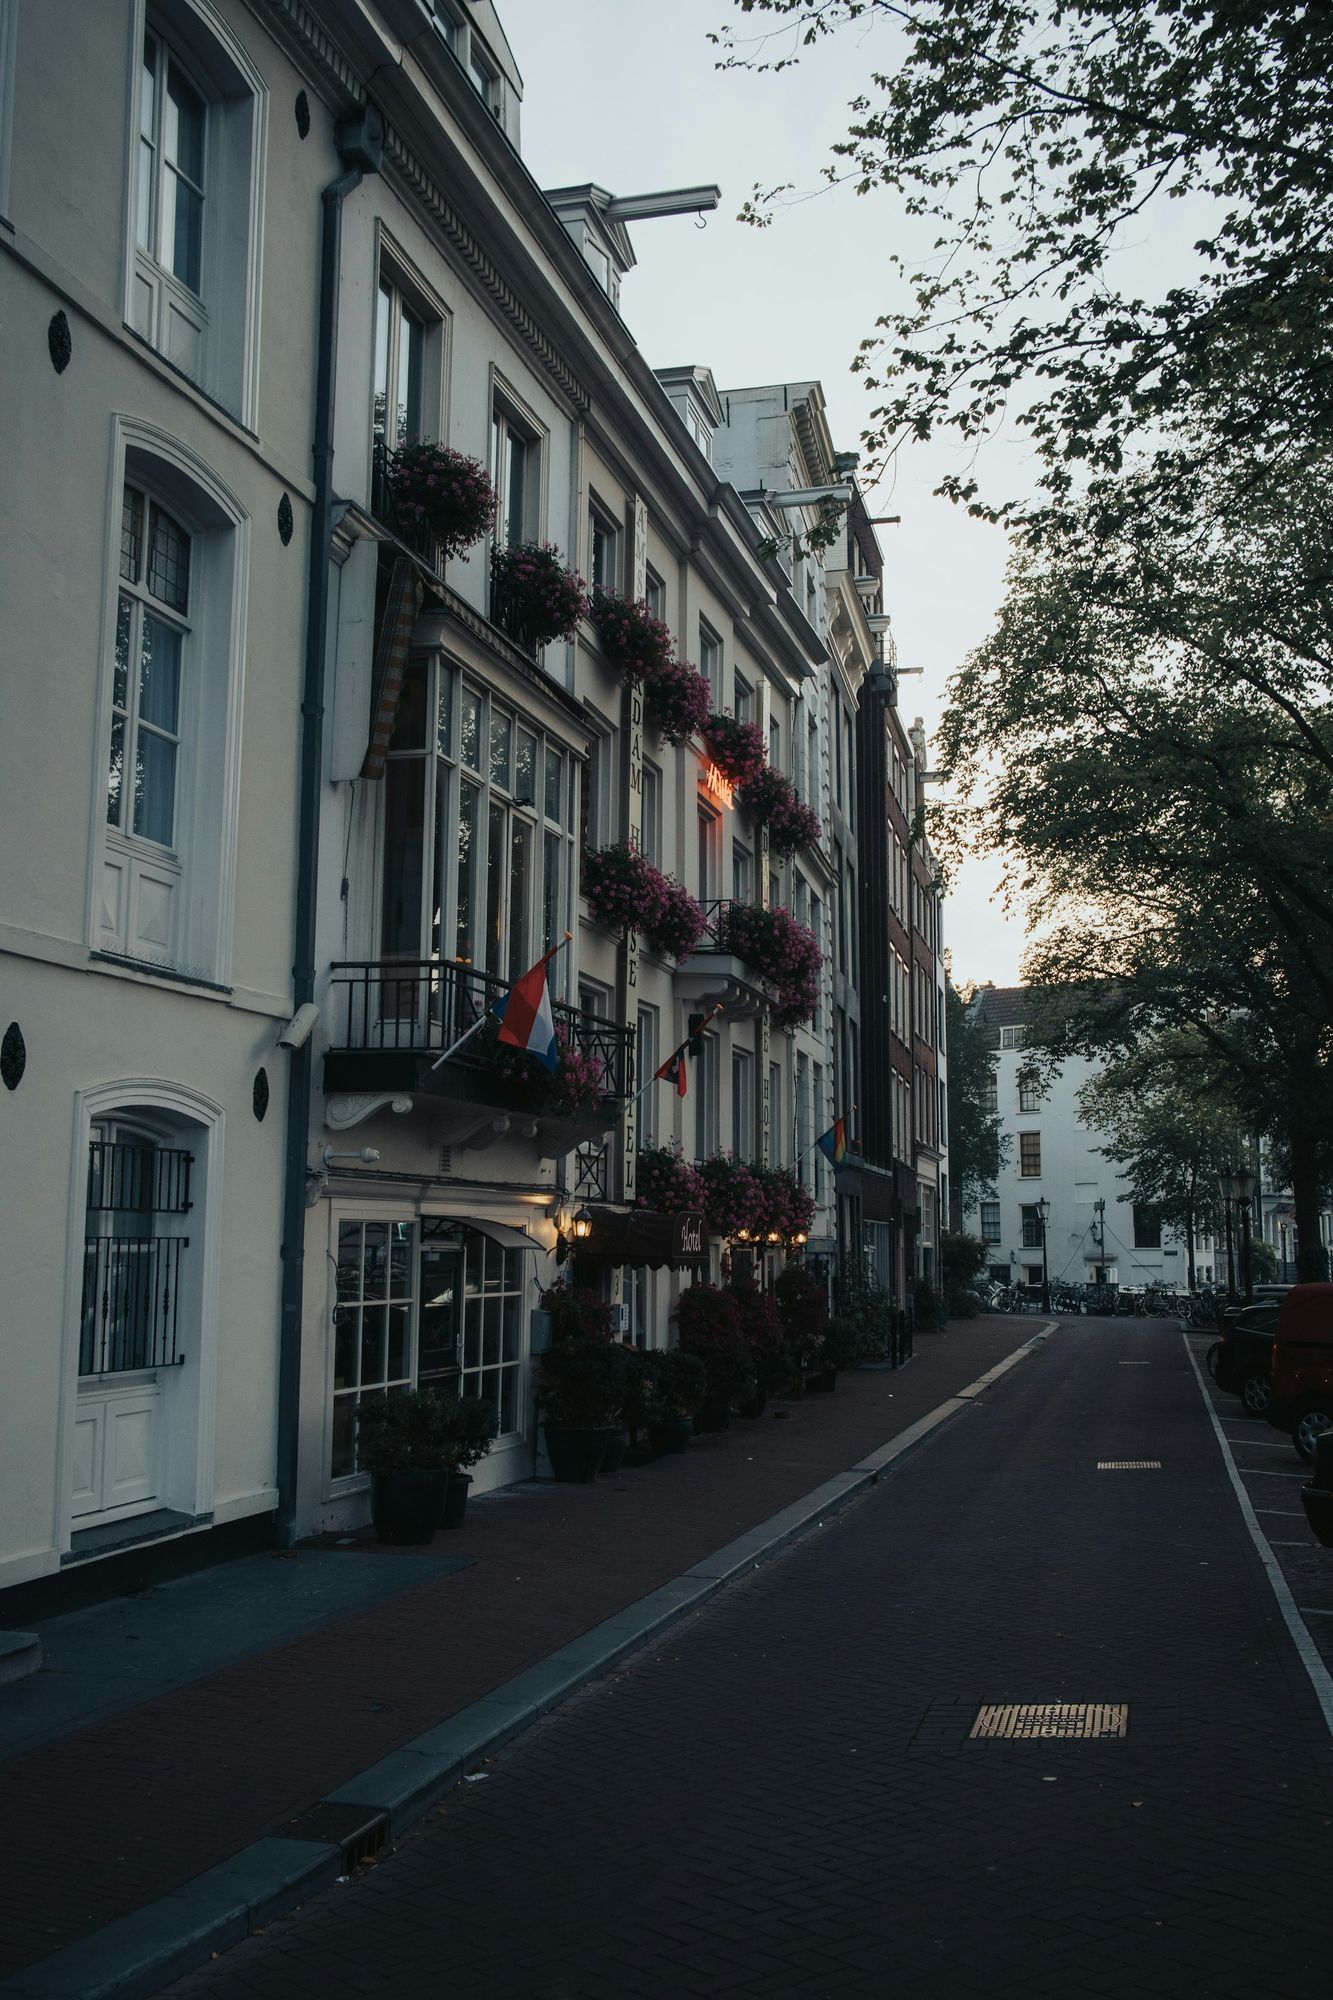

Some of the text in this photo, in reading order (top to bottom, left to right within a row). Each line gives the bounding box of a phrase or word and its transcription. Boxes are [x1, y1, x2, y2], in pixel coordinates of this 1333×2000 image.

[631, 507, 646, 795] AMSDAM
[628, 823, 640, 988] HSE
[681, 1217, 702, 1251] Hotel
